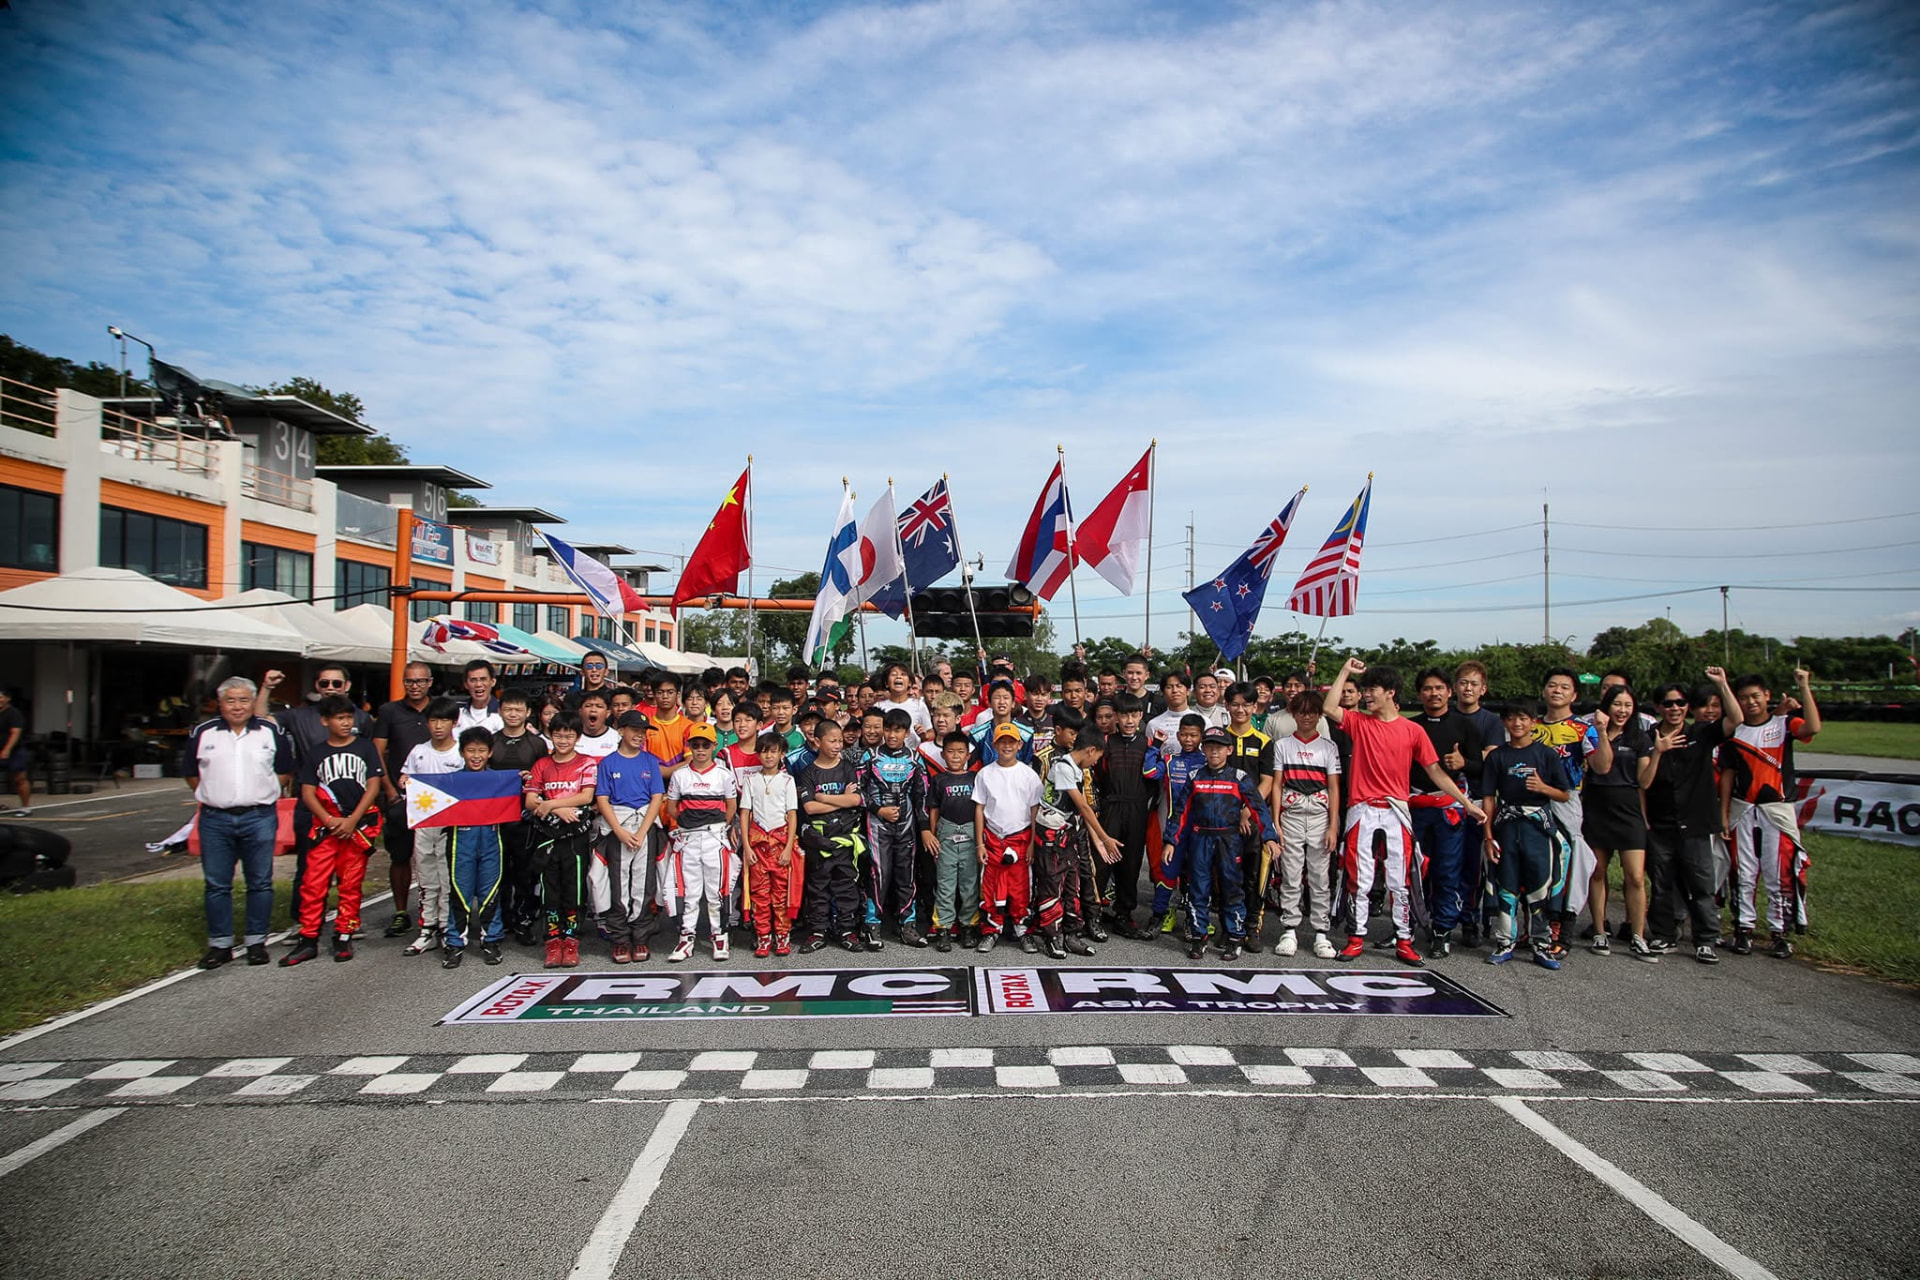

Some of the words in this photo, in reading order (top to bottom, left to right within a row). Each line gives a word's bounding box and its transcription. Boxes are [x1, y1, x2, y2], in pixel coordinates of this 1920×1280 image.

[945, 785, 973, 794] ROTA
[481, 980, 552, 1016] ROTAX
[562, 973, 951, 1001] RMC
[1000, 974, 1035, 1009] ROTAX
[1057, 972, 1437, 998] RMC
[547, 1005, 770, 1016] THAILAND
[1071, 999, 1177, 1010] ASIA
[1186, 1000, 1368, 1011] TROPHY
